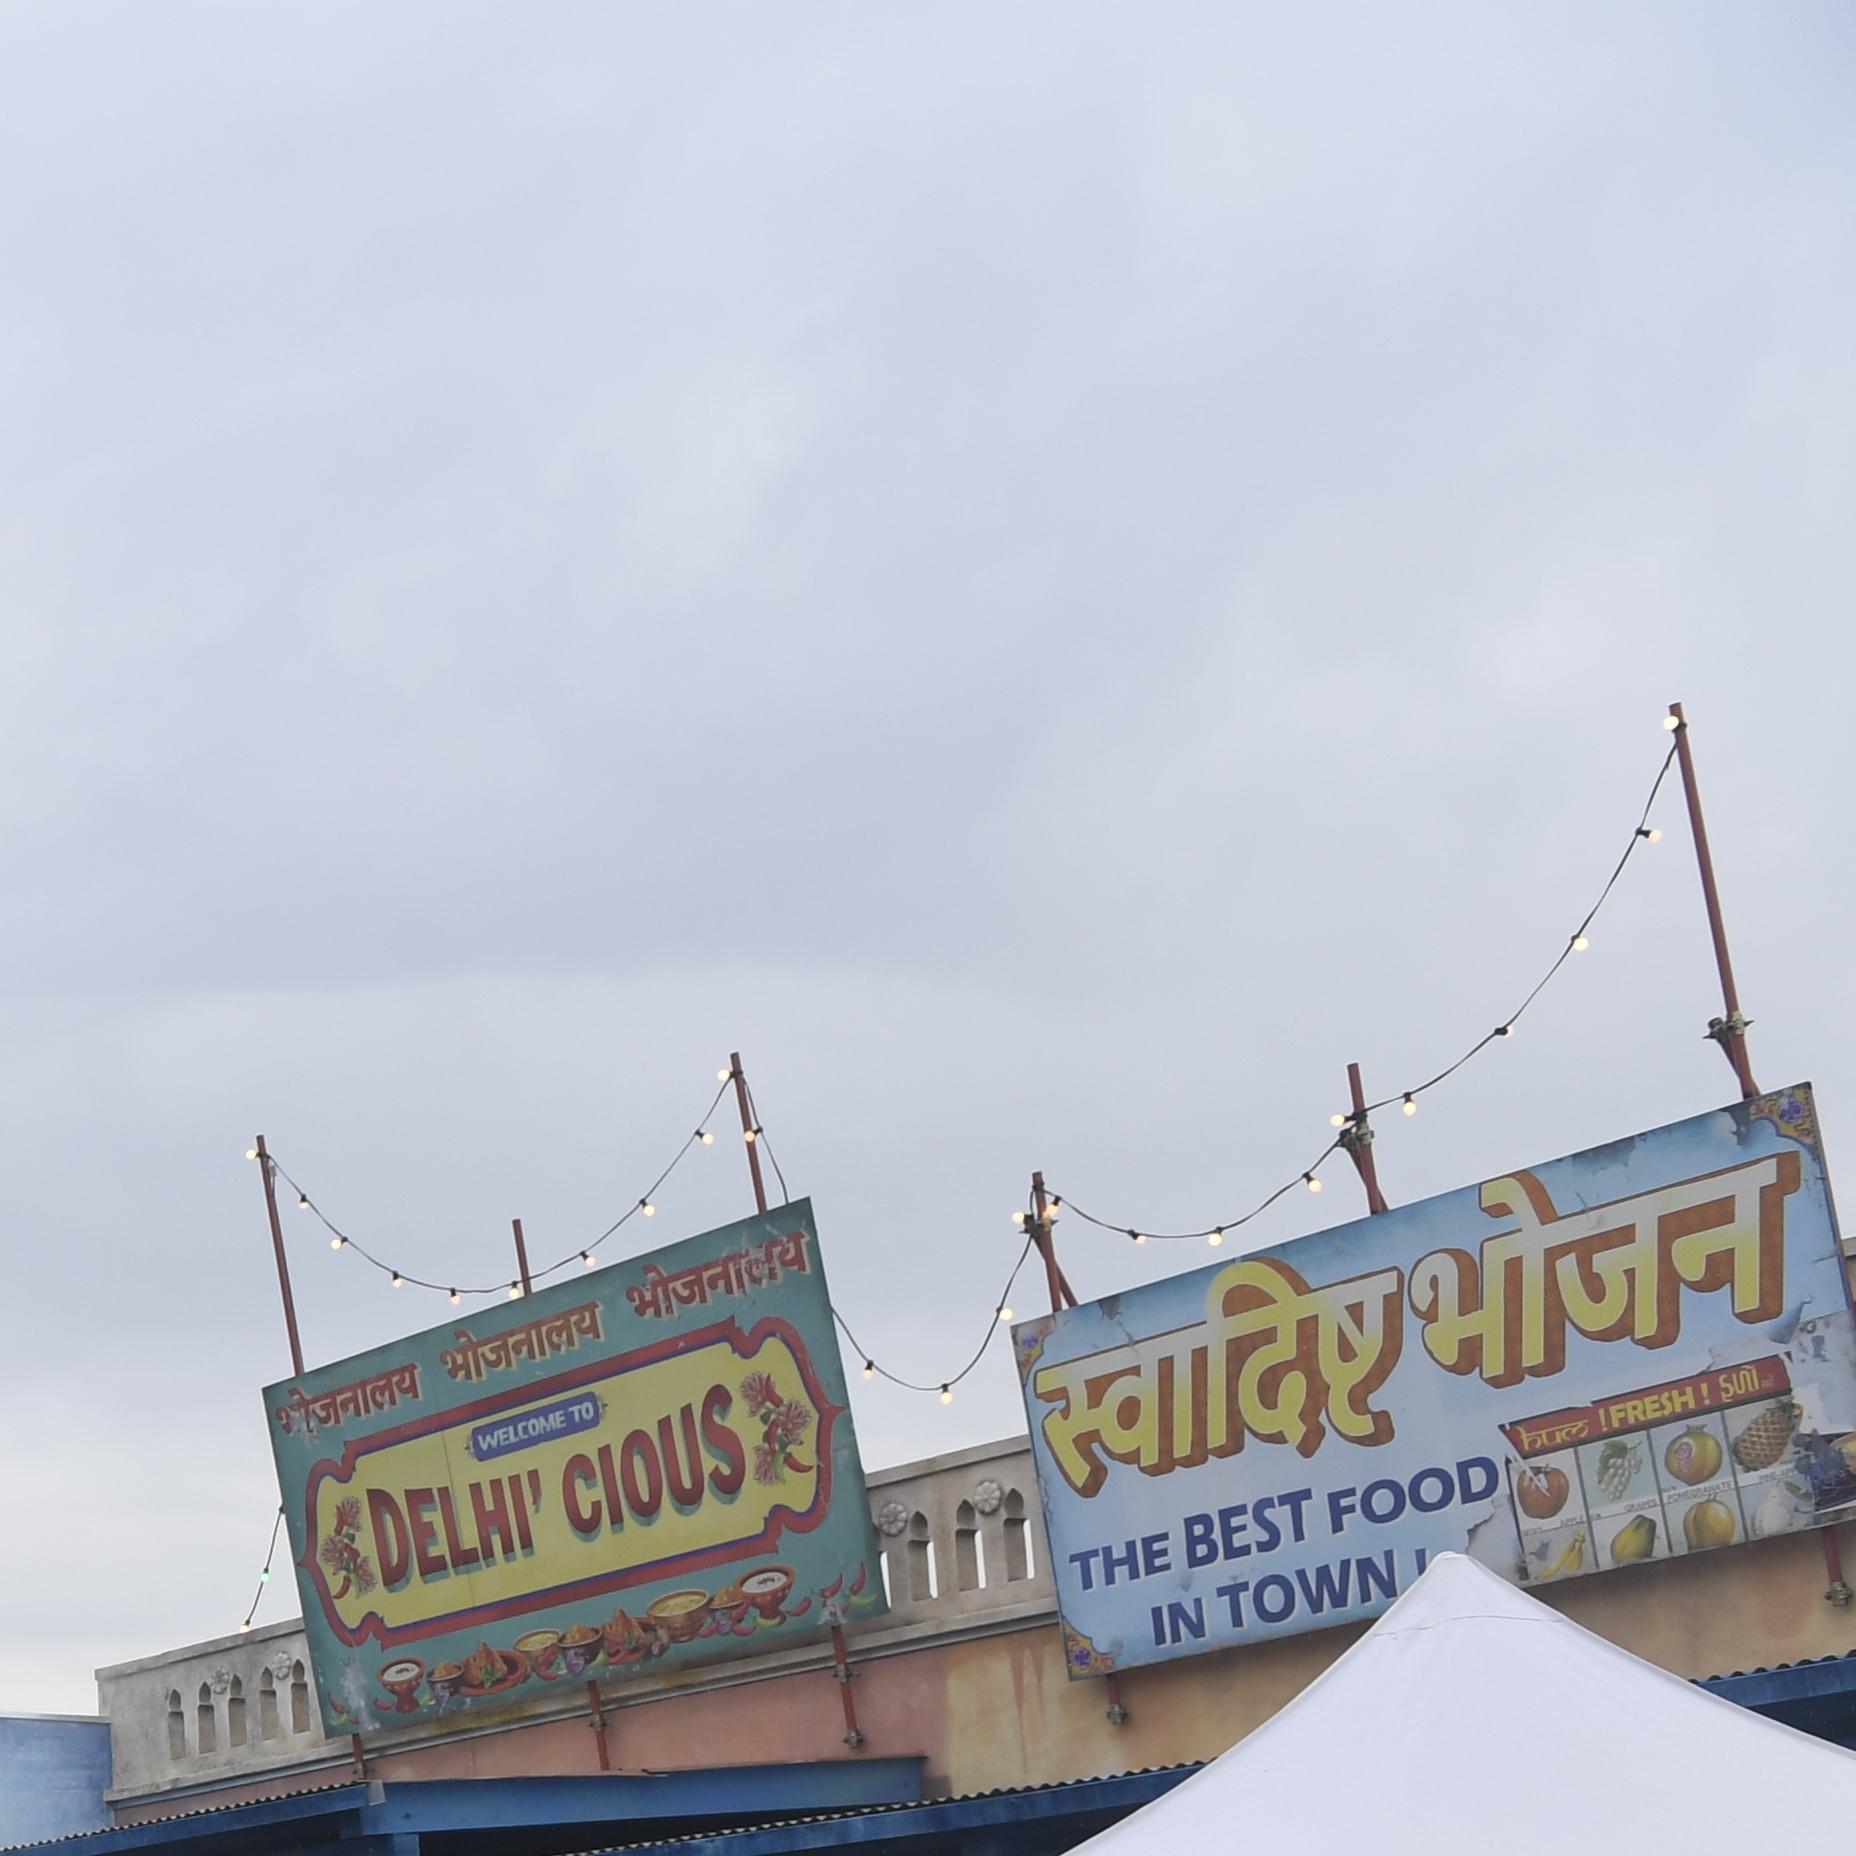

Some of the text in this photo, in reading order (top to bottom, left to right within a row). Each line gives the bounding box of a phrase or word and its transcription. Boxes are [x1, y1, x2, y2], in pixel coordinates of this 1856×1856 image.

[1409, 1150, 1801, 1388] भोजन
[440, 1300, 603, 1383] भोजनालय
[477, 1400, 595, 1453] WELCOME TO
[562, 1383, 748, 1543] CIOUS
[1068, 1455, 1500, 1594] THE BEST FOOD
[1149, 1597, 1206, 1648] IN
[1214, 1548, 1400, 1631] TOWN
